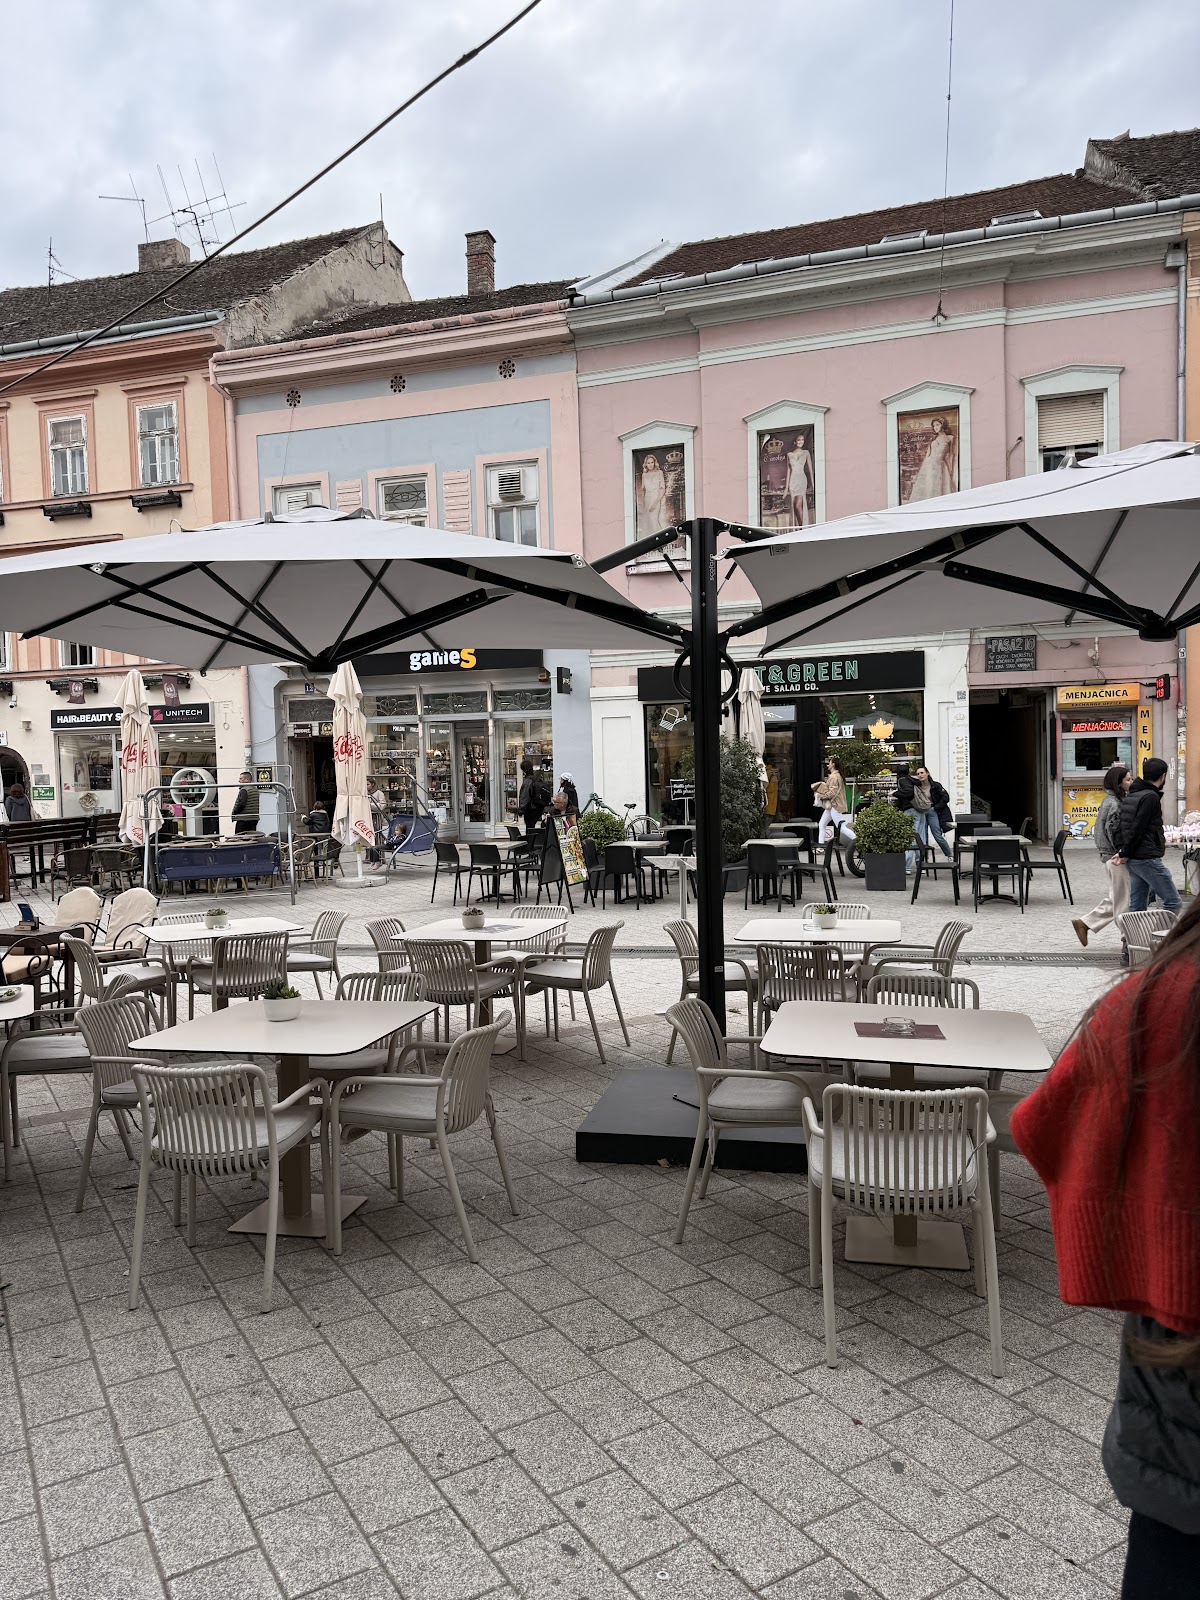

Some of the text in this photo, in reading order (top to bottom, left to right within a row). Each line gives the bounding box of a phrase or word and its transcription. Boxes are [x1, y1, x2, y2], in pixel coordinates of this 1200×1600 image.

[754, 660, 859, 684] T&GREEN
[774, 684, 801, 693] SALAD
[804, 682, 820, 691] CO.
[1065, 689, 1129, 700] MENJAČNICA
[56, 713, 113, 724] HAIR&BEAUTY
[165, 709, 203, 717] UNITECH
[1072, 720, 1125, 732] MENJAČNICA
